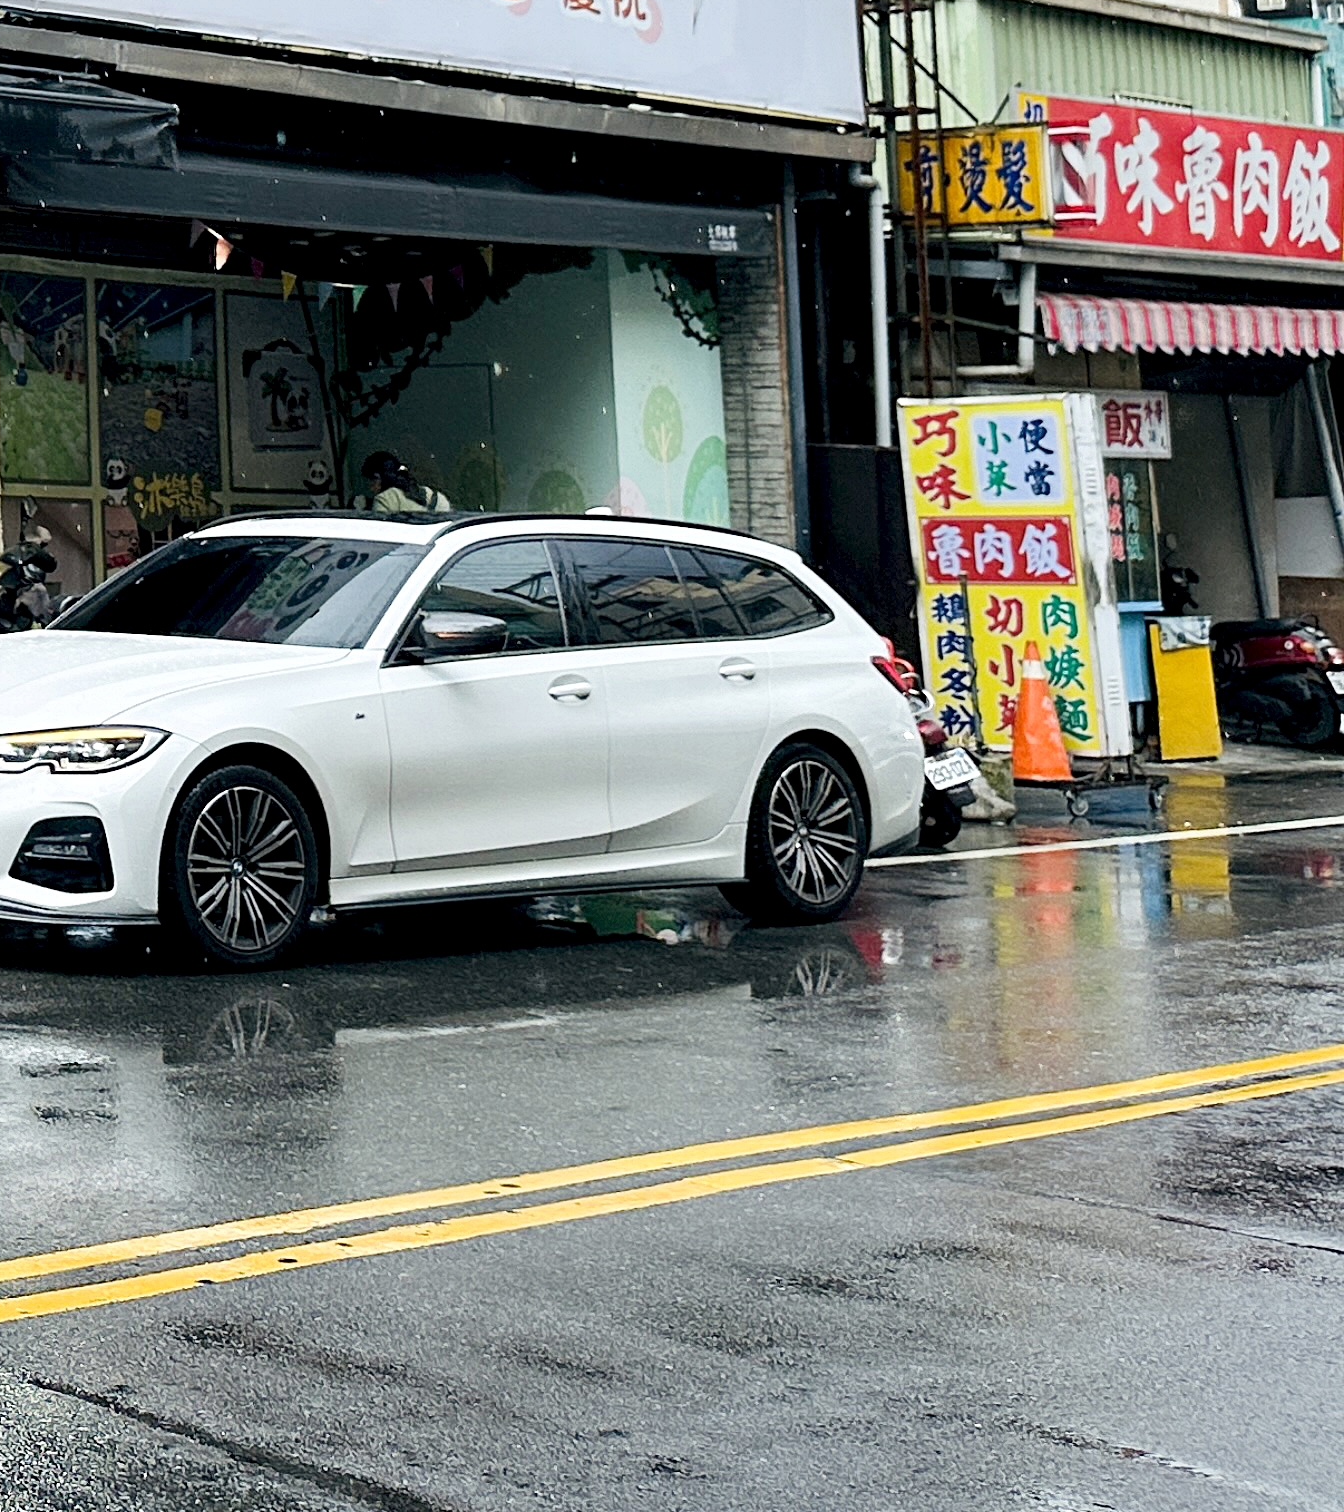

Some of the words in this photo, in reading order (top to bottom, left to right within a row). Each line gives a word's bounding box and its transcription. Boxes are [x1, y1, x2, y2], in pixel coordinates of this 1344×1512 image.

[912, 410, 972, 510] 巧味
[977, 420, 1017, 497] 小菜
[1018, 419, 1055, 497] 便當
[927, 523, 1072, 579] 魯肉飯
